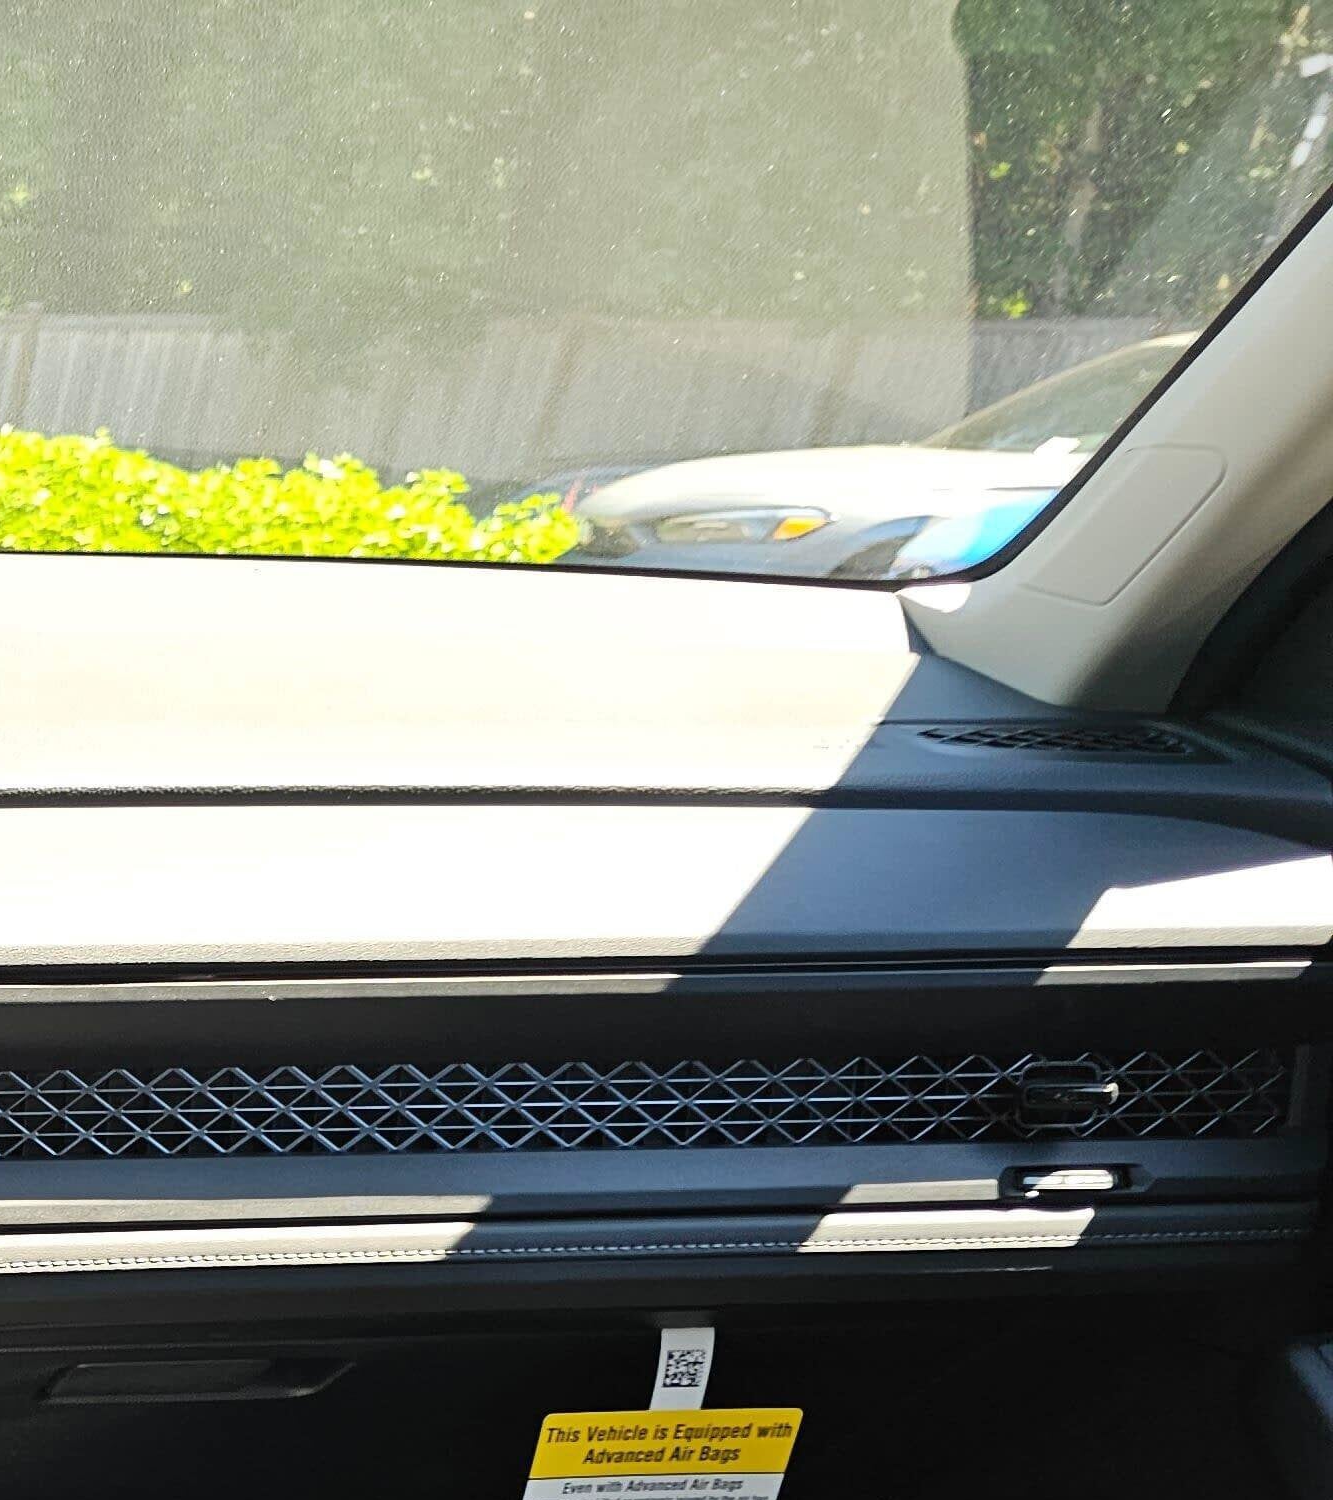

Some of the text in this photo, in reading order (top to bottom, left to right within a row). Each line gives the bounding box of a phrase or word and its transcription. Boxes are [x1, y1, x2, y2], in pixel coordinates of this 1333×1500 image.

[546, 1422, 793, 1443] This Vehicle is Equipped with
[582, 1445, 742, 1464] Advanced Air Bags
[625, 1480, 688, 1492] Advanced
[689, 1479, 710, 1490] Air
[711, 1478, 744, 1492] Bags
